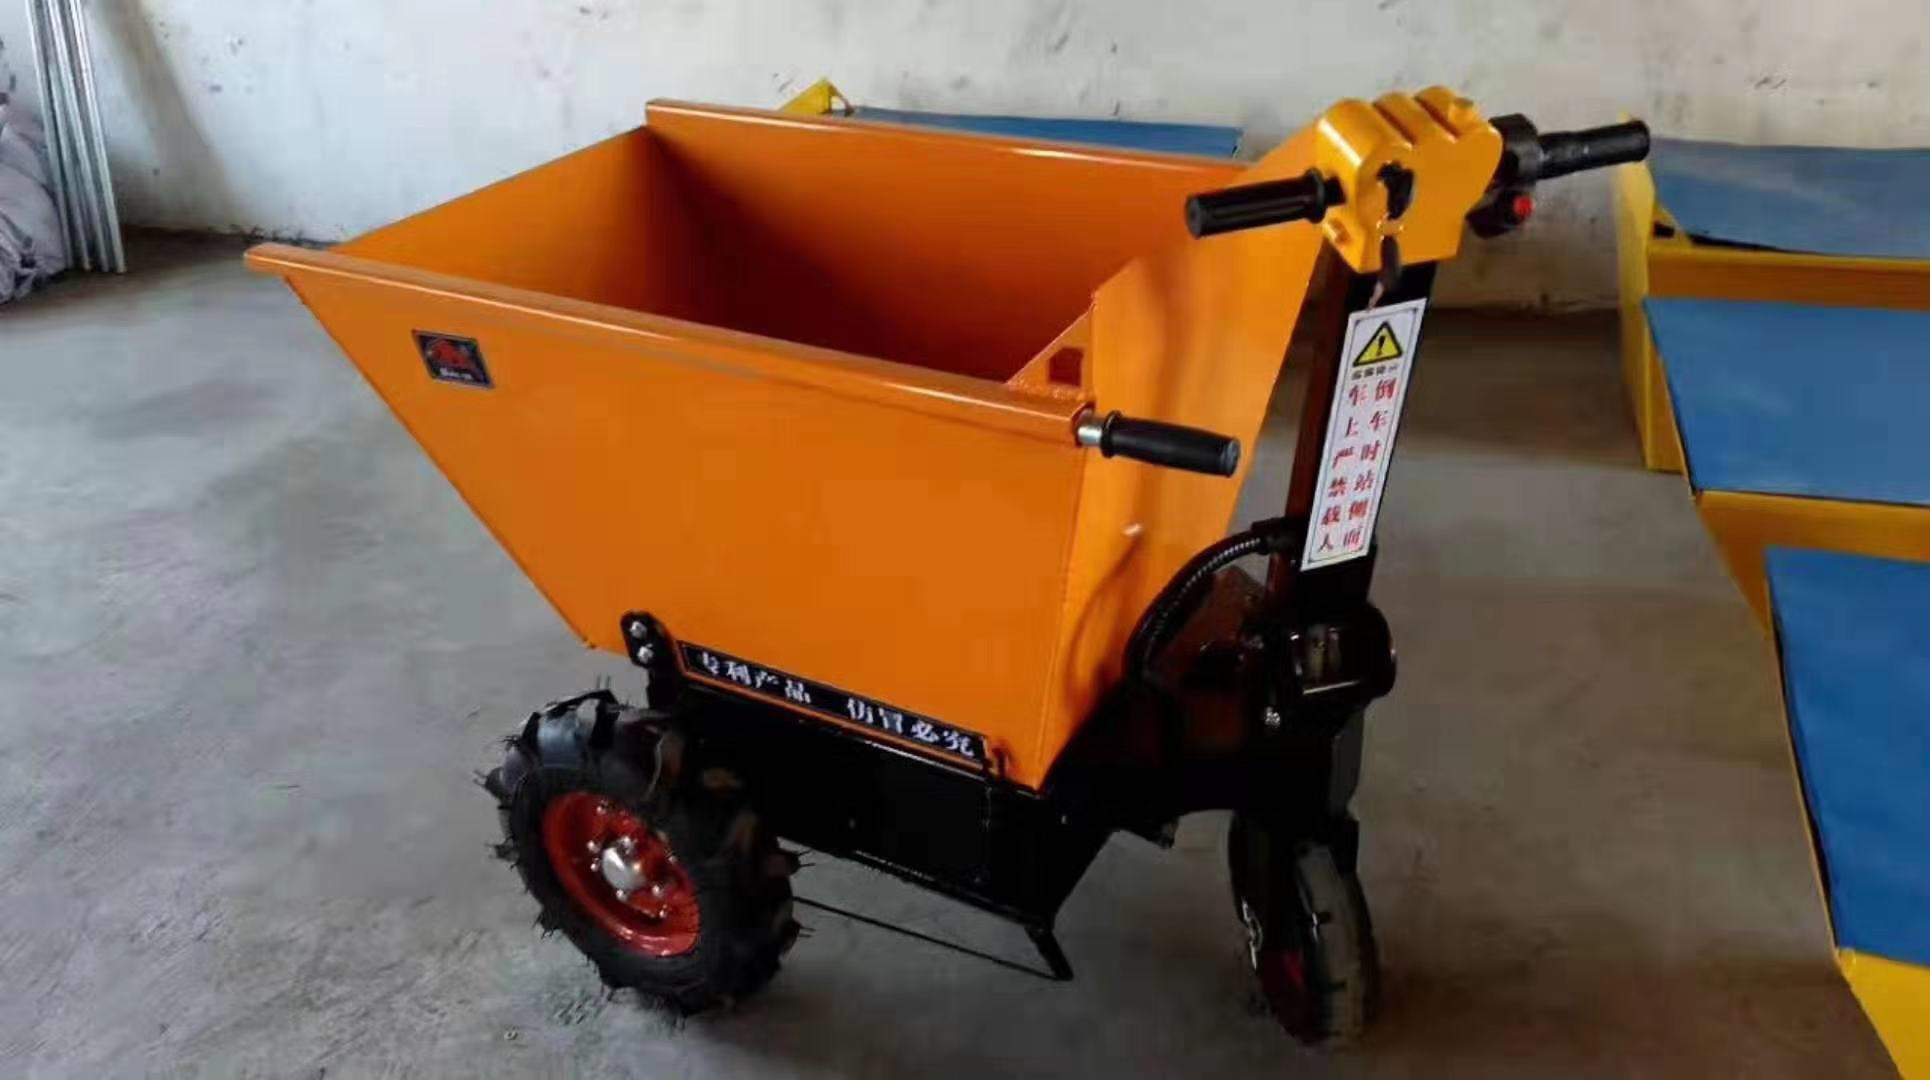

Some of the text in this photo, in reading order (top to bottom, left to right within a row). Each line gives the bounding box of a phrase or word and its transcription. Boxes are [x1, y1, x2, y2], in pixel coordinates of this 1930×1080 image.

[1319, 384, 1368, 551] 车上严禁载人
[1343, 377, 1398, 551] 倒车时站侧面
[701, 651, 811, 704] 专利产品
